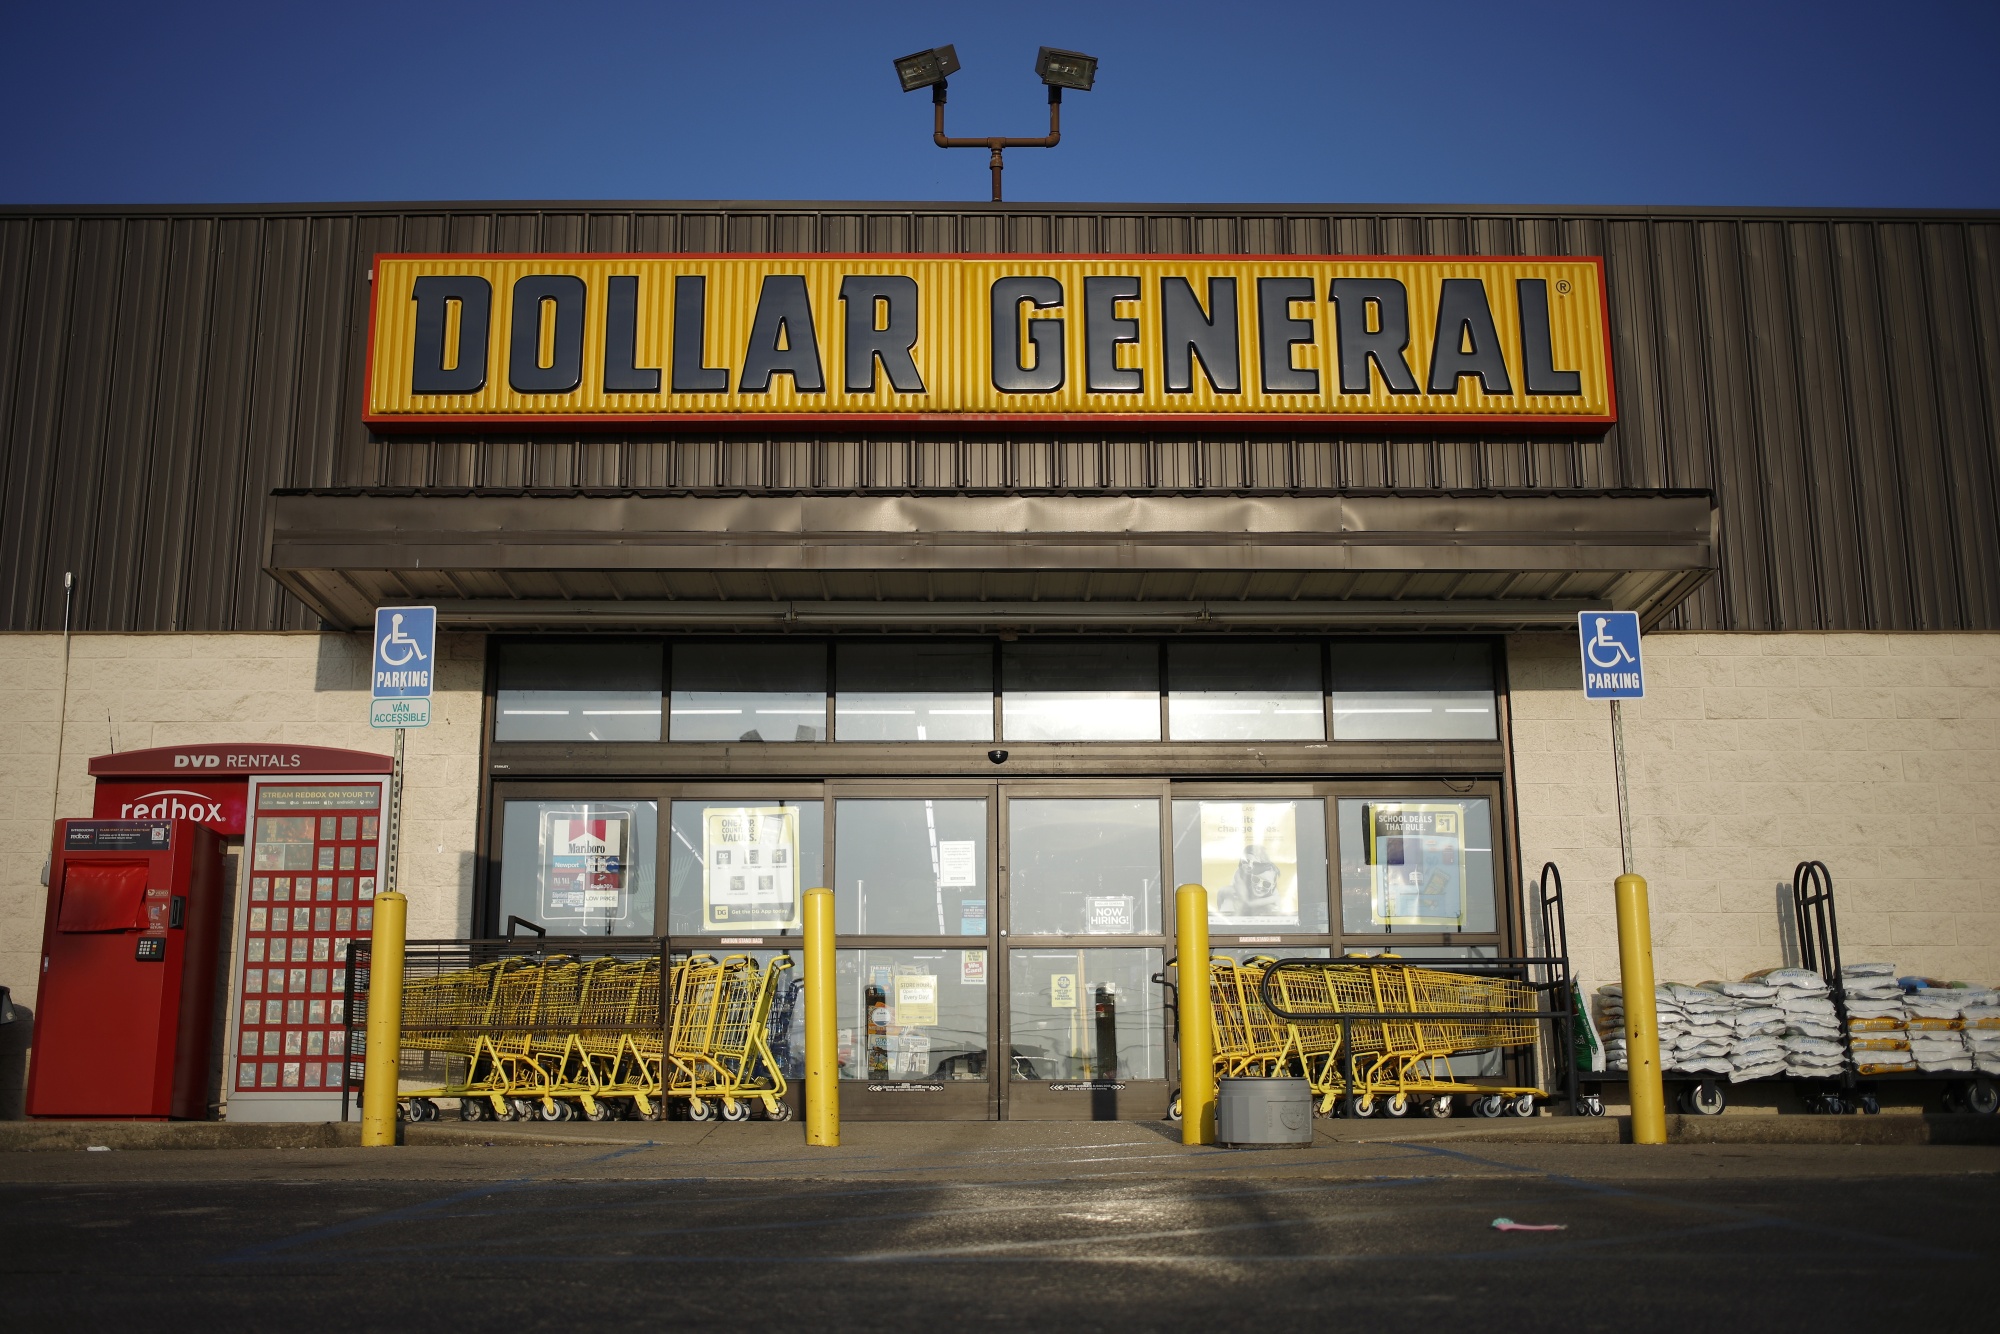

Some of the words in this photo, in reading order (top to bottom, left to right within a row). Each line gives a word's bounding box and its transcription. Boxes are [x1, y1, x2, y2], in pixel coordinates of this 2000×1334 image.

[411, 275, 928, 395] DOLLAR
[990, 276, 1582, 397] GENERAL
[376, 670, 429, 688] PARKING
[1588, 672, 1640, 689] PARKING
[392, 703, 410, 713] VAN
[374, 712, 427, 723] ACCESSIBLE
[174, 755, 220, 768] DVD
[226, 754, 301, 768] RENTALS
[262, 791, 294, 799] STREAM
[121, 798, 222, 822] redbox
[721, 819, 738, 827] ONE
[1378, 815, 1408, 823] SCHOOL
[1409, 815, 1432, 823] DEALS
[1385, 823, 1404, 831] THAT
[1405, 823, 1426, 831] RULE.
[1439, 818, 1451, 831] $1
[722, 833, 757, 842] VALUS.
[568, 840, 606, 854] Marlboro
[1096, 907, 1123, 916] NOW
[1090, 916, 1130, 925] HIRING!
